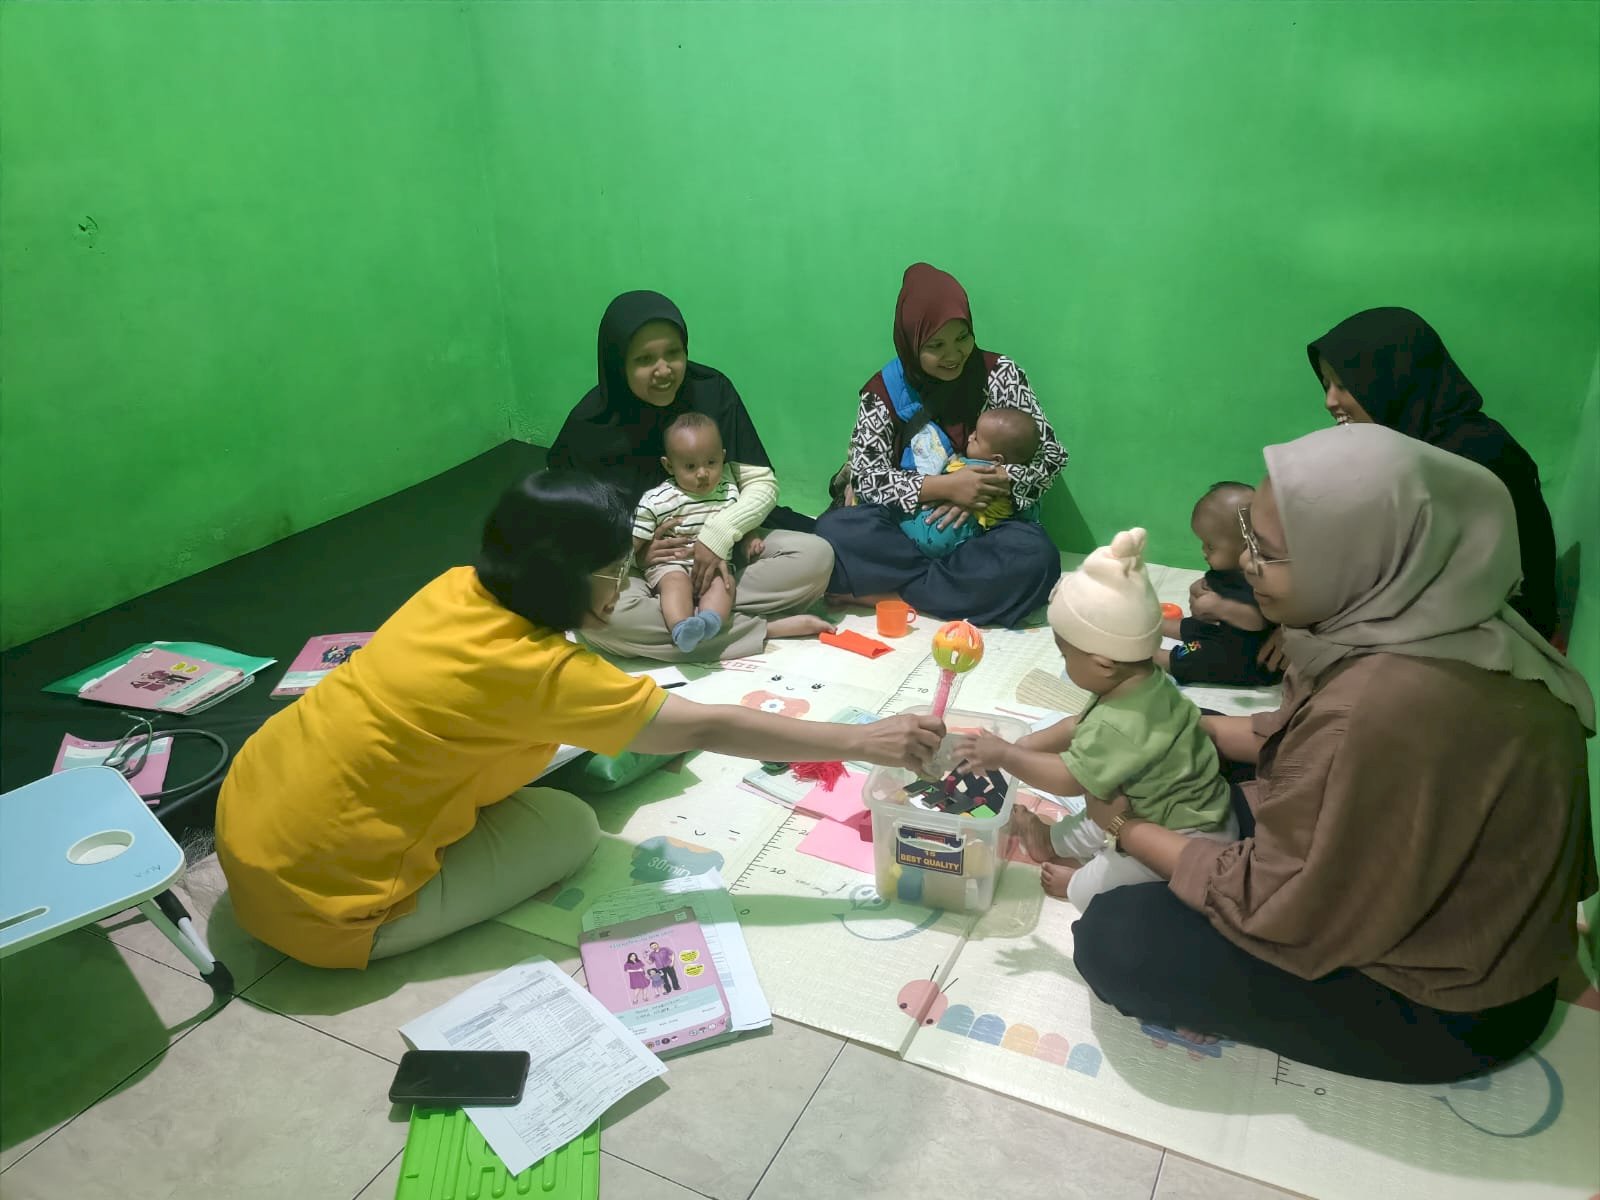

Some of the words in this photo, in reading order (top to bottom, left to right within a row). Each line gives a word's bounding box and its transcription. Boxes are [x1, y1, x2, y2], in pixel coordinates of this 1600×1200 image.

[648, 856, 690, 878] 30min
[901, 854, 921, 863] BEST
[923, 859, 959, 870] QUALITY
[769, 867, 786, 875] 10
